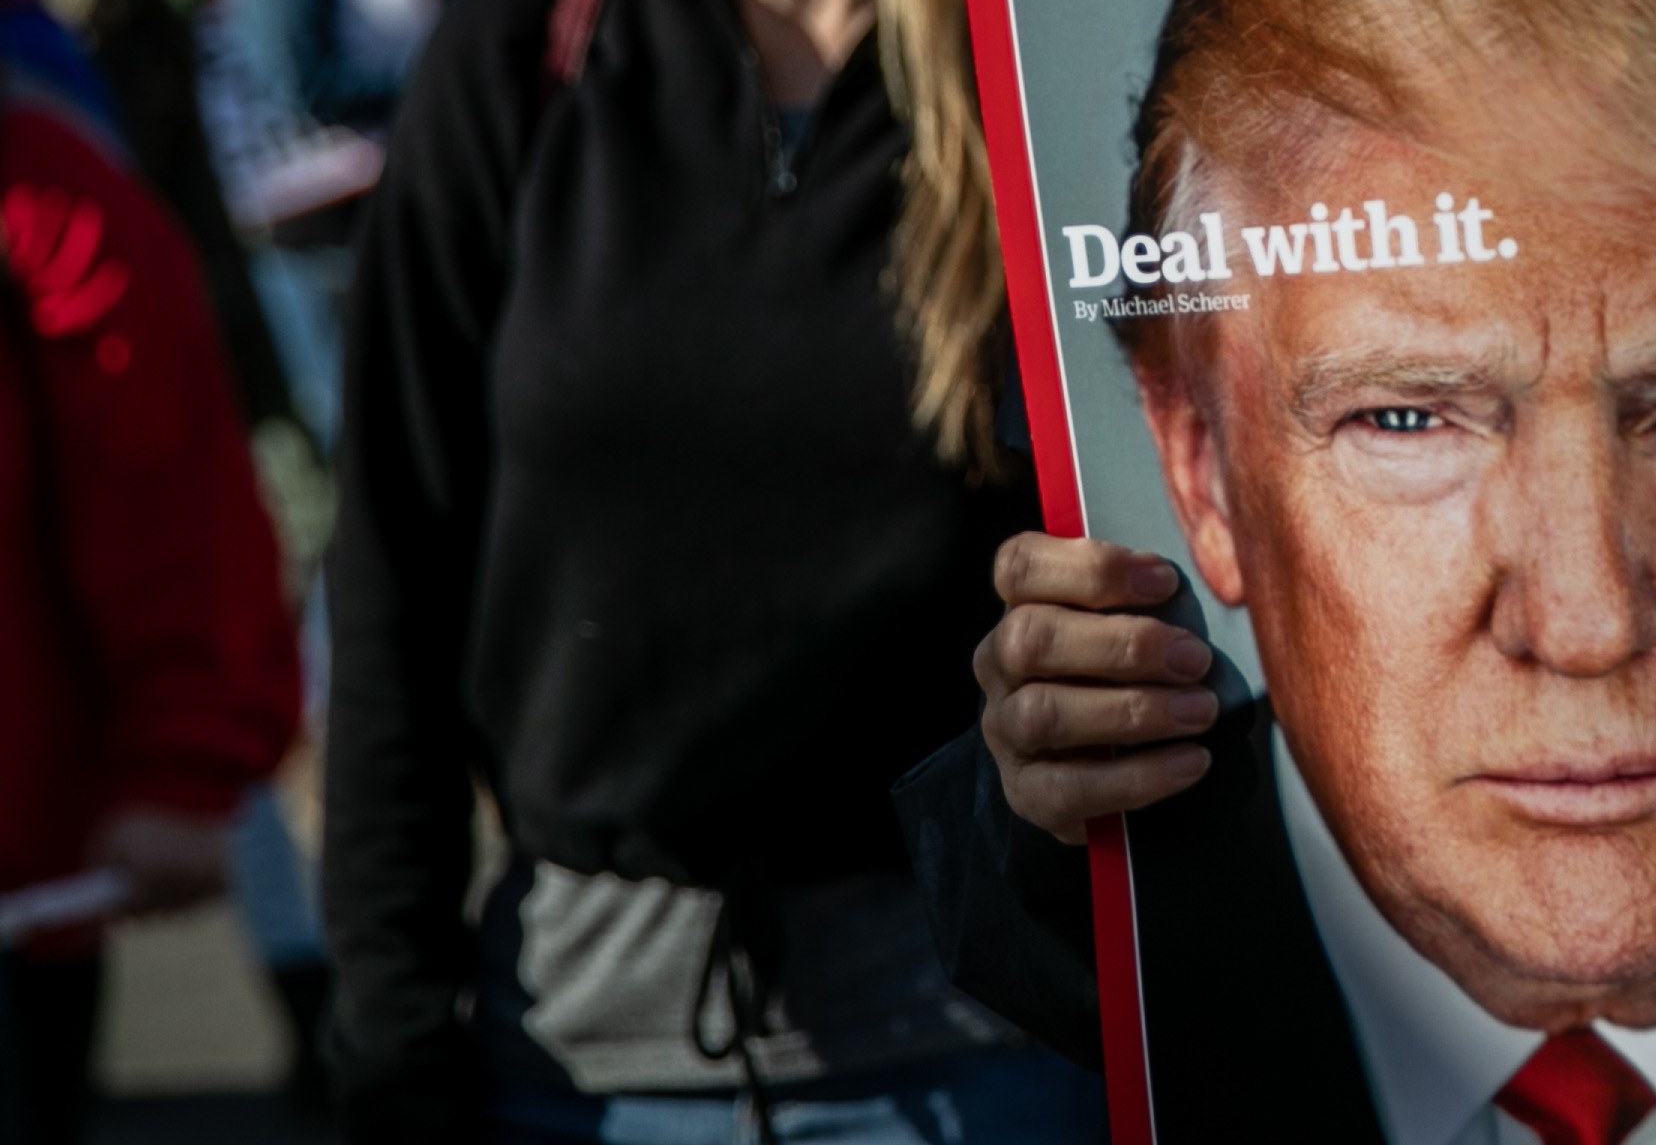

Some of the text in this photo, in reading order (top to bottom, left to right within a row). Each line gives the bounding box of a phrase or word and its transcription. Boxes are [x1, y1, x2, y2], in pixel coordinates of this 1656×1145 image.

[1061, 191, 1519, 289] Deal with it.
[1073, 292, 1251, 322] By Michael Scherer
